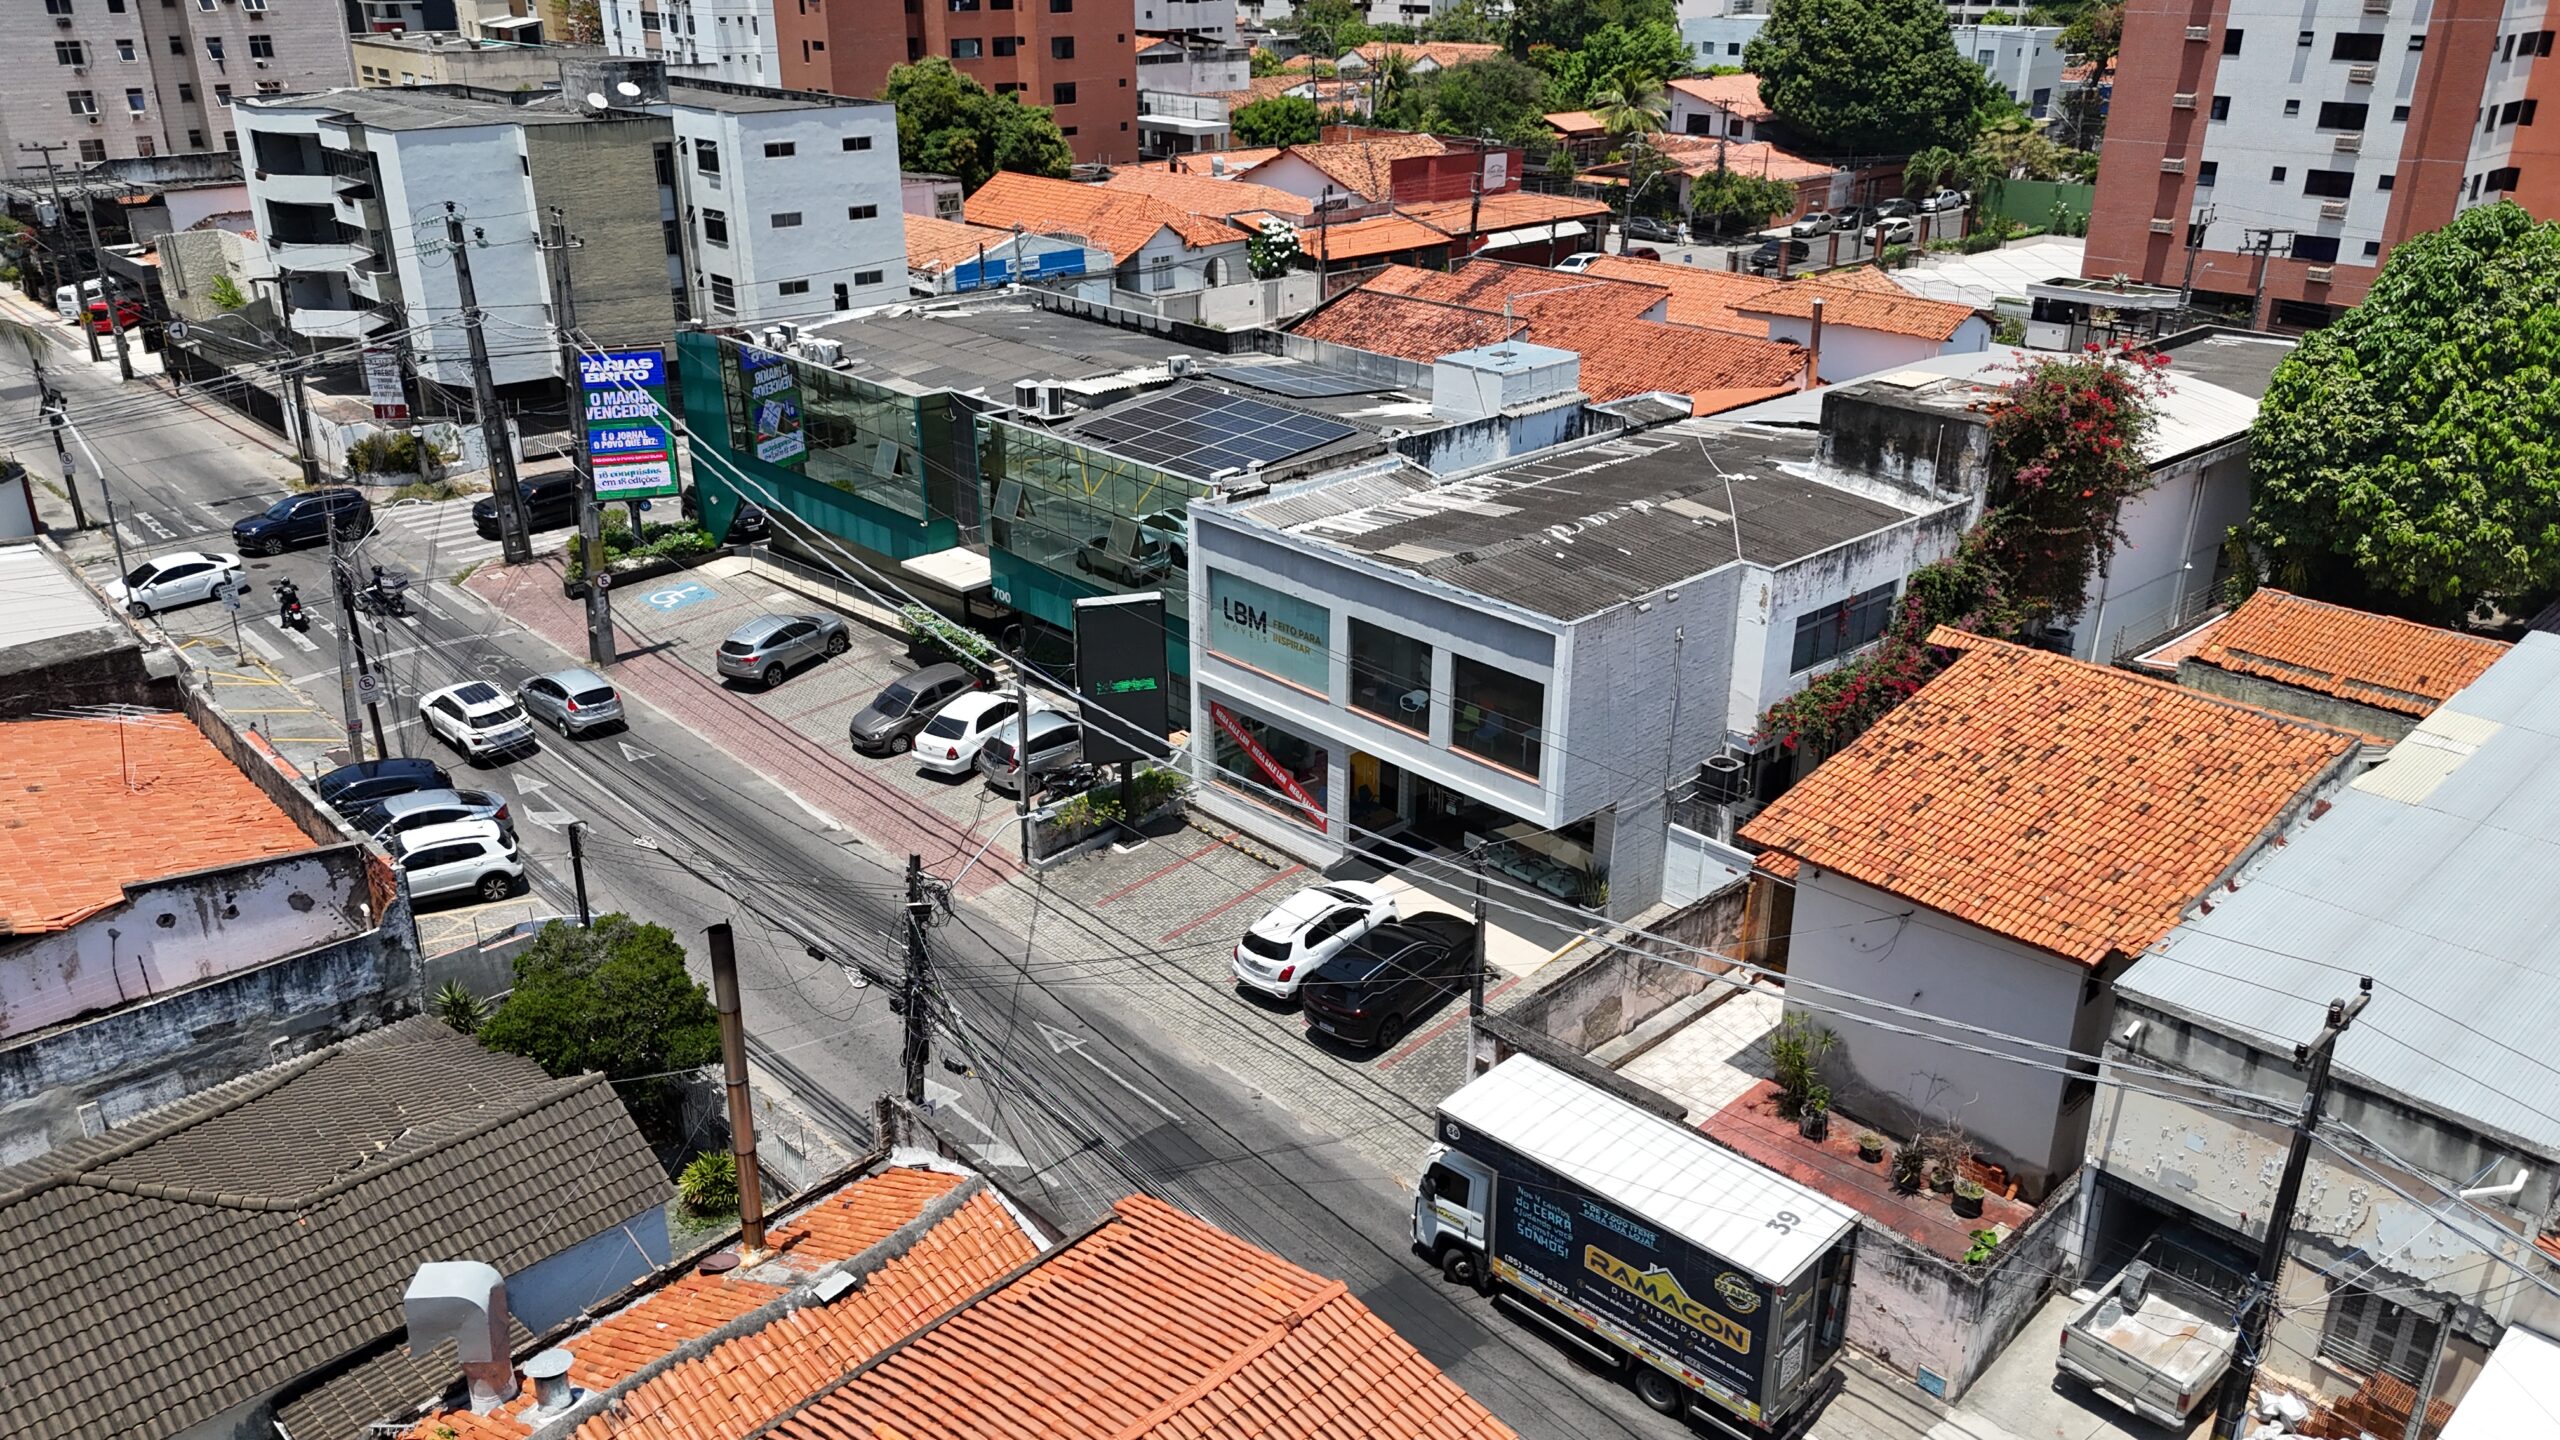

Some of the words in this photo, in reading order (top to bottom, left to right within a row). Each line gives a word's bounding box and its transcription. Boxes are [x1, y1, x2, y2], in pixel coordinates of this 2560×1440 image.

[580, 358, 654, 373] FARIAS
[584, 369, 649, 383] BRITO
[590, 393, 601, 406] O
[603, 389, 649, 404] MAIOR
[585, 403, 659, 420] VENCEDOR
[602, 430, 607, 440] É
[617, 430, 648, 440] JORNAL
[602, 439, 624, 449] POVO
[625, 438, 641, 447] QUE
[993, 587, 1012, 604] 700
[1223, 596, 1267, 634] LBM
[1272, 619, 1297, 636] FEITO
[1298, 629, 1321, 646] PARA
[1272, 634, 1312, 655] INSPIRAR
[1215, 708, 1229, 726] MEGA
[1228, 719, 1240, 738] SALE
[1239, 731, 1250, 747] LBM
[1251, 745, 1265, 763] MEGA
[1264, 757, 1277, 775] SALE
[1275, 769, 1287, 784] LBM
[1288, 783, 1303, 802] MEGA
[1447, 1126, 1459, 1139] 39
[1516, 1196, 1529, 1210] do
[1518, 1186, 1533, 1200] Nos
[1584, 1209, 1606, 1225] PARA
[1609, 1221, 1627, 1234] SUA
[1589, 1205, 1600, 1215] DE
[1629, 1224, 1656, 1242] ITENS
[1765, 1210, 1801, 1236] 39
[1517, 1223, 1569, 1259] SONHOS!
[1590, 1251, 1744, 1348] RAMACON
[1715, 1280, 1729, 1292] 23
[1730, 1287, 1760, 1305] ANOS
[1611, 1286, 1717, 1350] DISTRIBUIDORA
